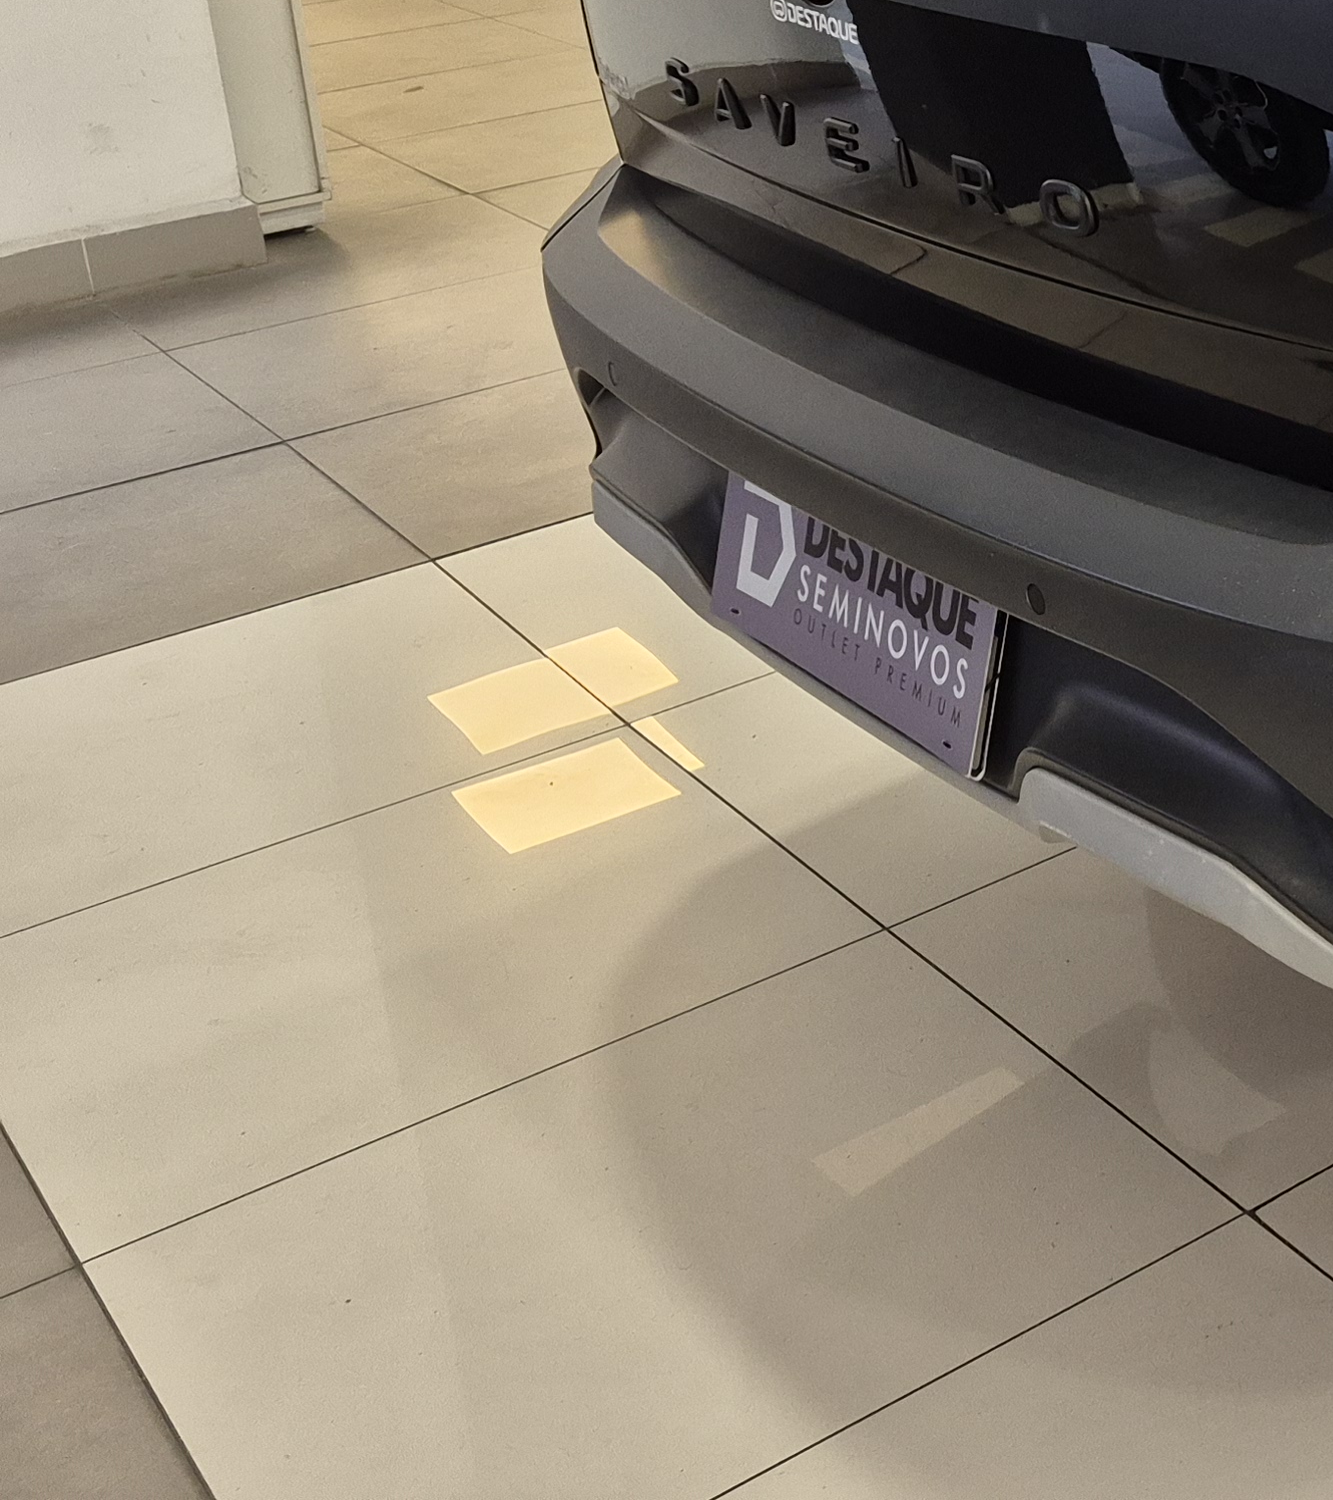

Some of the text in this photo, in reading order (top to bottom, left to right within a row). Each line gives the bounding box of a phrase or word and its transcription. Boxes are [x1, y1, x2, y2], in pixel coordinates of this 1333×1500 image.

[665, 56, 1099, 238] SAVEIRO
[793, 608, 962, 729] OUTLET PREMIUM
[797, 564, 969, 699] SEMINOVOS
